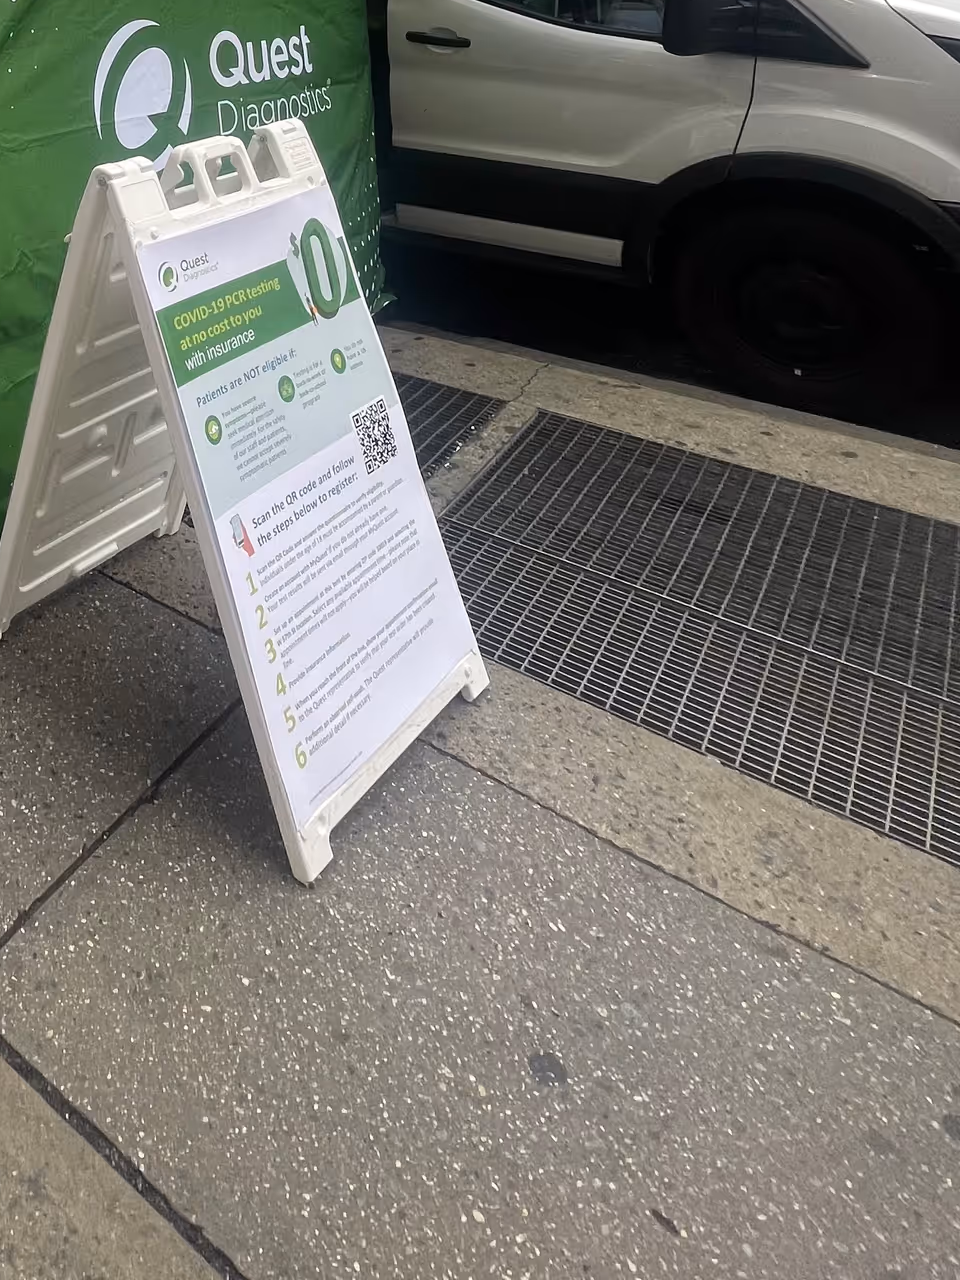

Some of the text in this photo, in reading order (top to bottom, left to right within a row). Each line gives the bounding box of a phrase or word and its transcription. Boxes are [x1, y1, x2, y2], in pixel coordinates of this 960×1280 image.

[209, 25, 313, 87] Quest
[180, 252, 209, 272] Quest
[289, 218, 342, 319] $0
[174, 278, 280, 330] COVID-19 PCR testing
[180, 305, 262, 350] at no cost to you
[185, 329, 255, 371] with insurance
[196, 348, 297, 408] Patients are NOT eligible if:
[252, 456, 354, 529] Scan the QR code and follow
[257, 532, 272, 547] the
[273, 516, 294, 536] steps
[293, 499, 317, 521] below
[318, 493, 327, 504] to
[328, 472, 358, 498] register:
[246, 571, 258, 596] 1
[255, 604, 268, 630] 2
[264, 638, 277, 664] 3
[276, 672, 287, 696] 4
[283, 705, 296, 733] 5
[295, 741, 307, 769] 6
